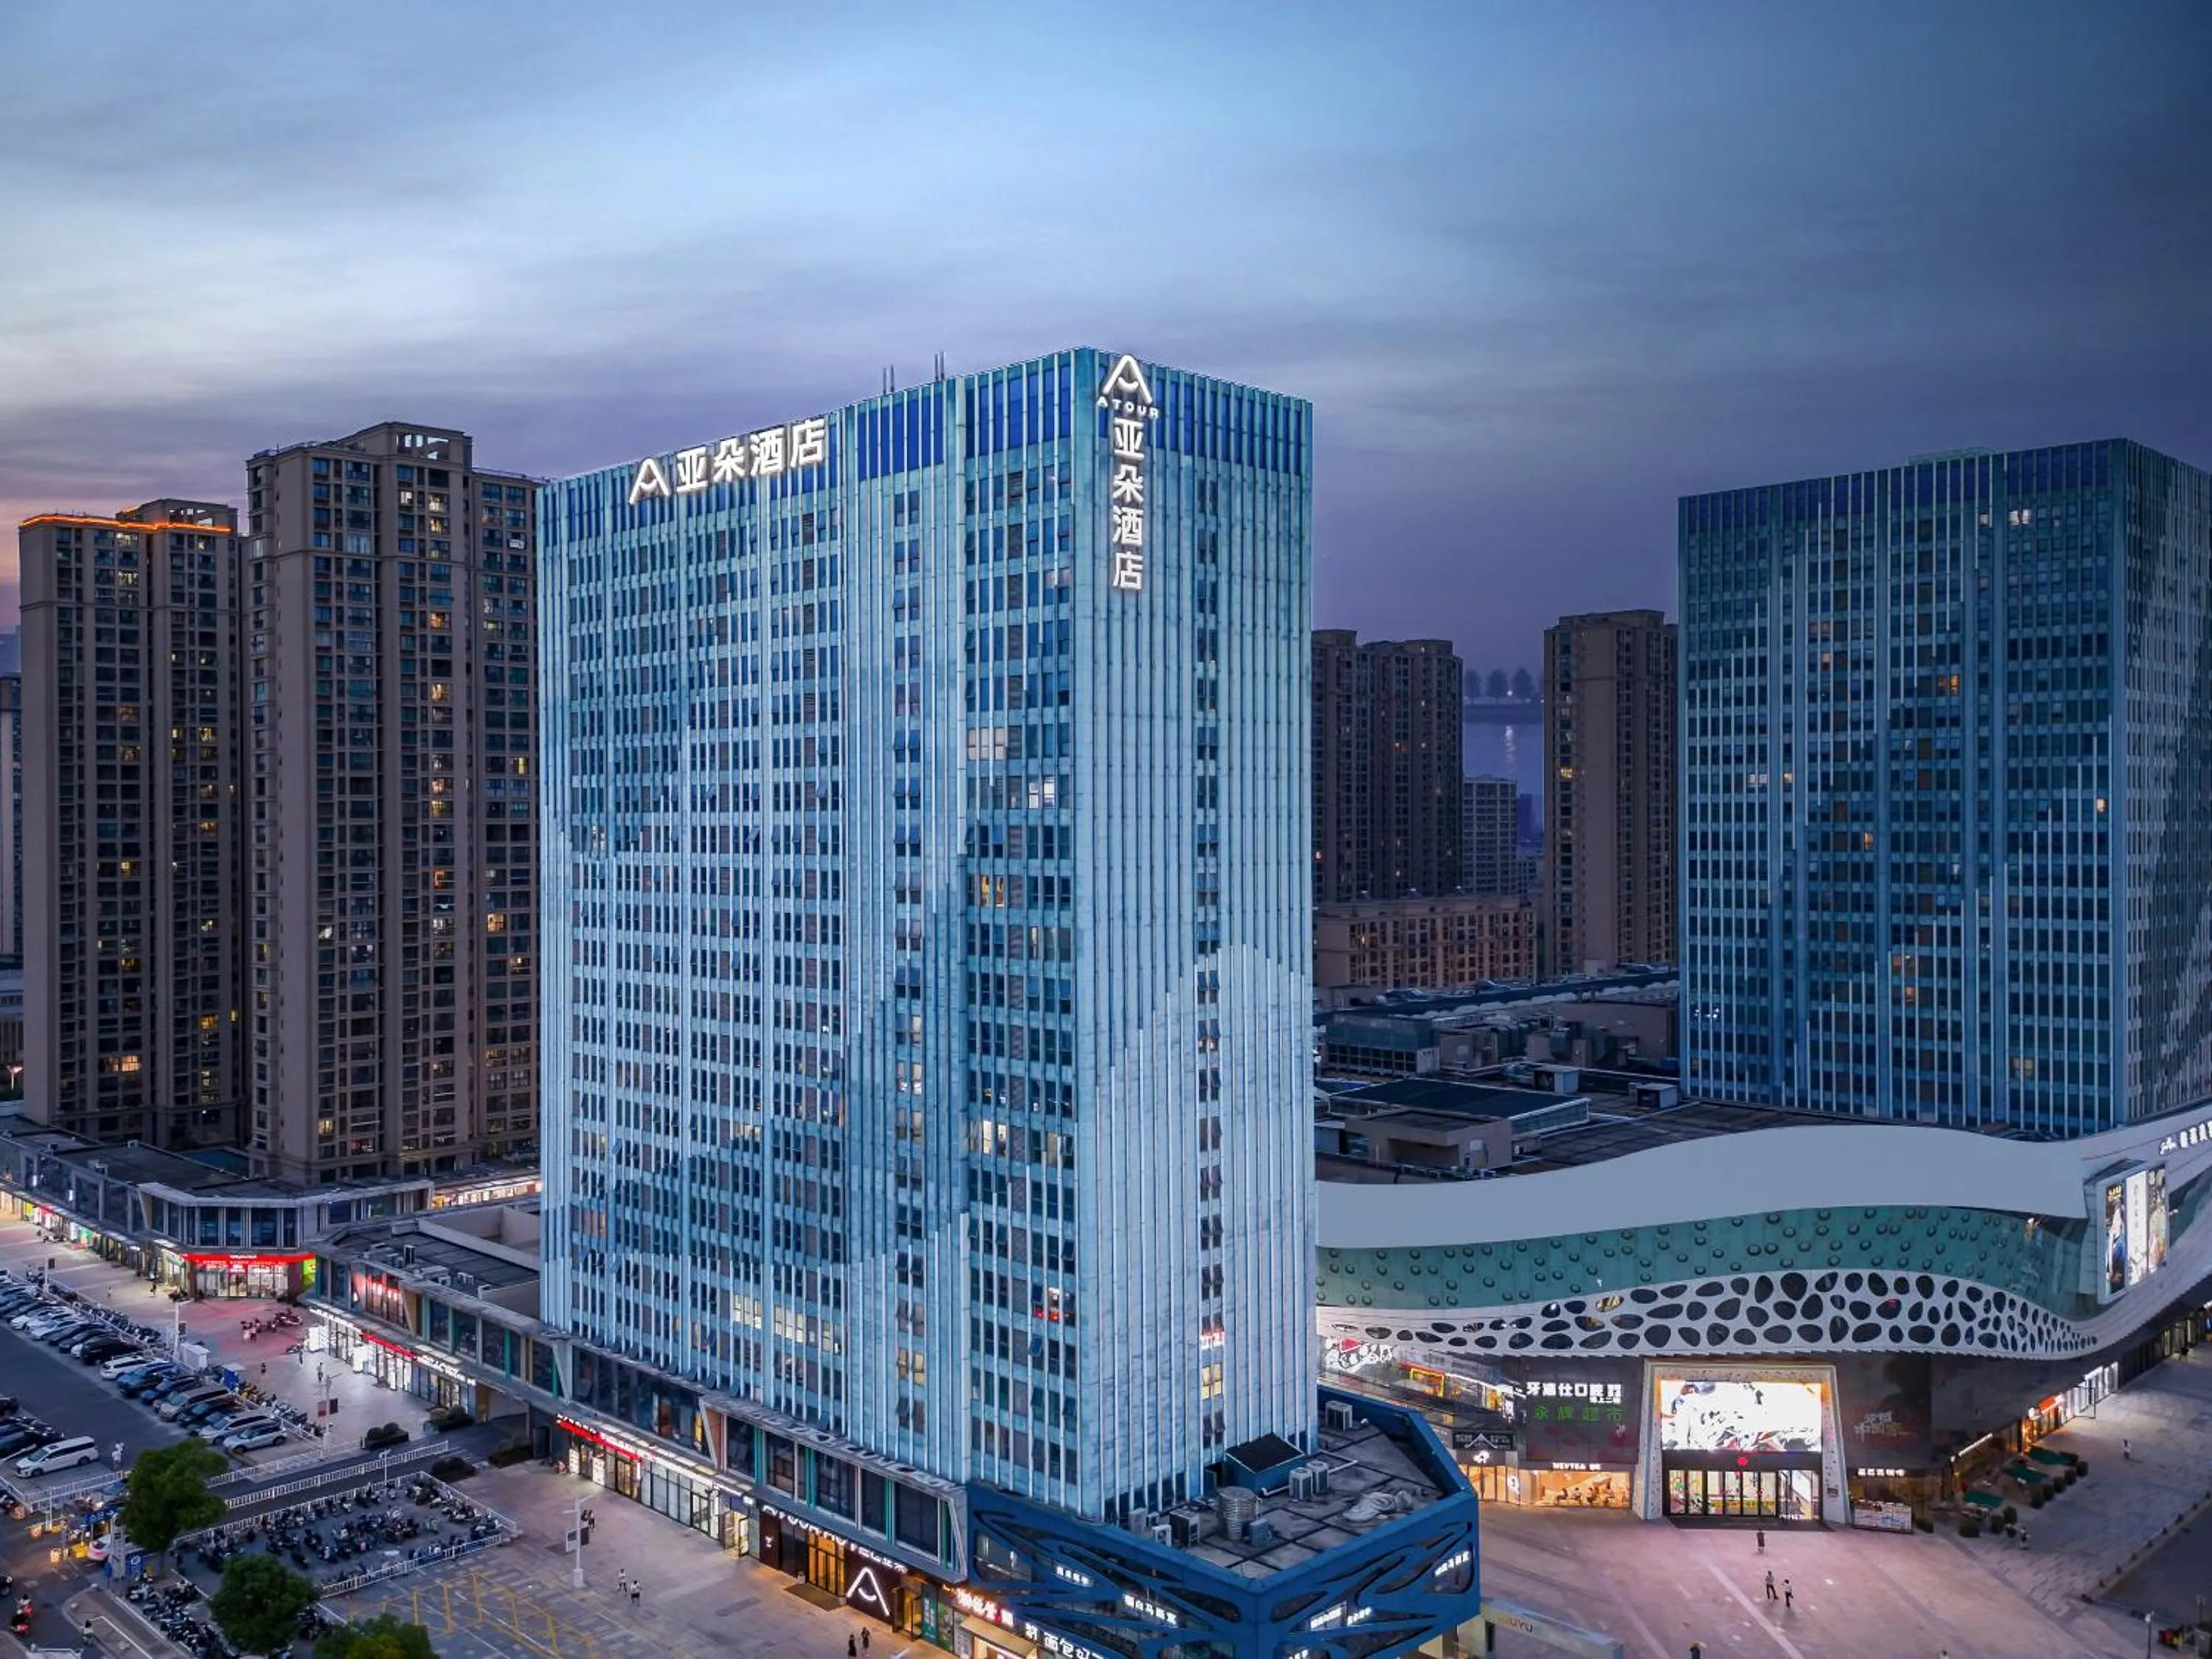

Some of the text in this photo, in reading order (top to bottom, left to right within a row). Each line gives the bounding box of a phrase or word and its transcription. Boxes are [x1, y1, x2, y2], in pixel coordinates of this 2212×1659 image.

[1096, 396, 1159, 420] ATOUR
[676, 418, 825, 493] 亚朵酒店
[1112, 417, 1145, 591] 亚朵酒店
[1043, 1632, 1105, 1659] 面包好
